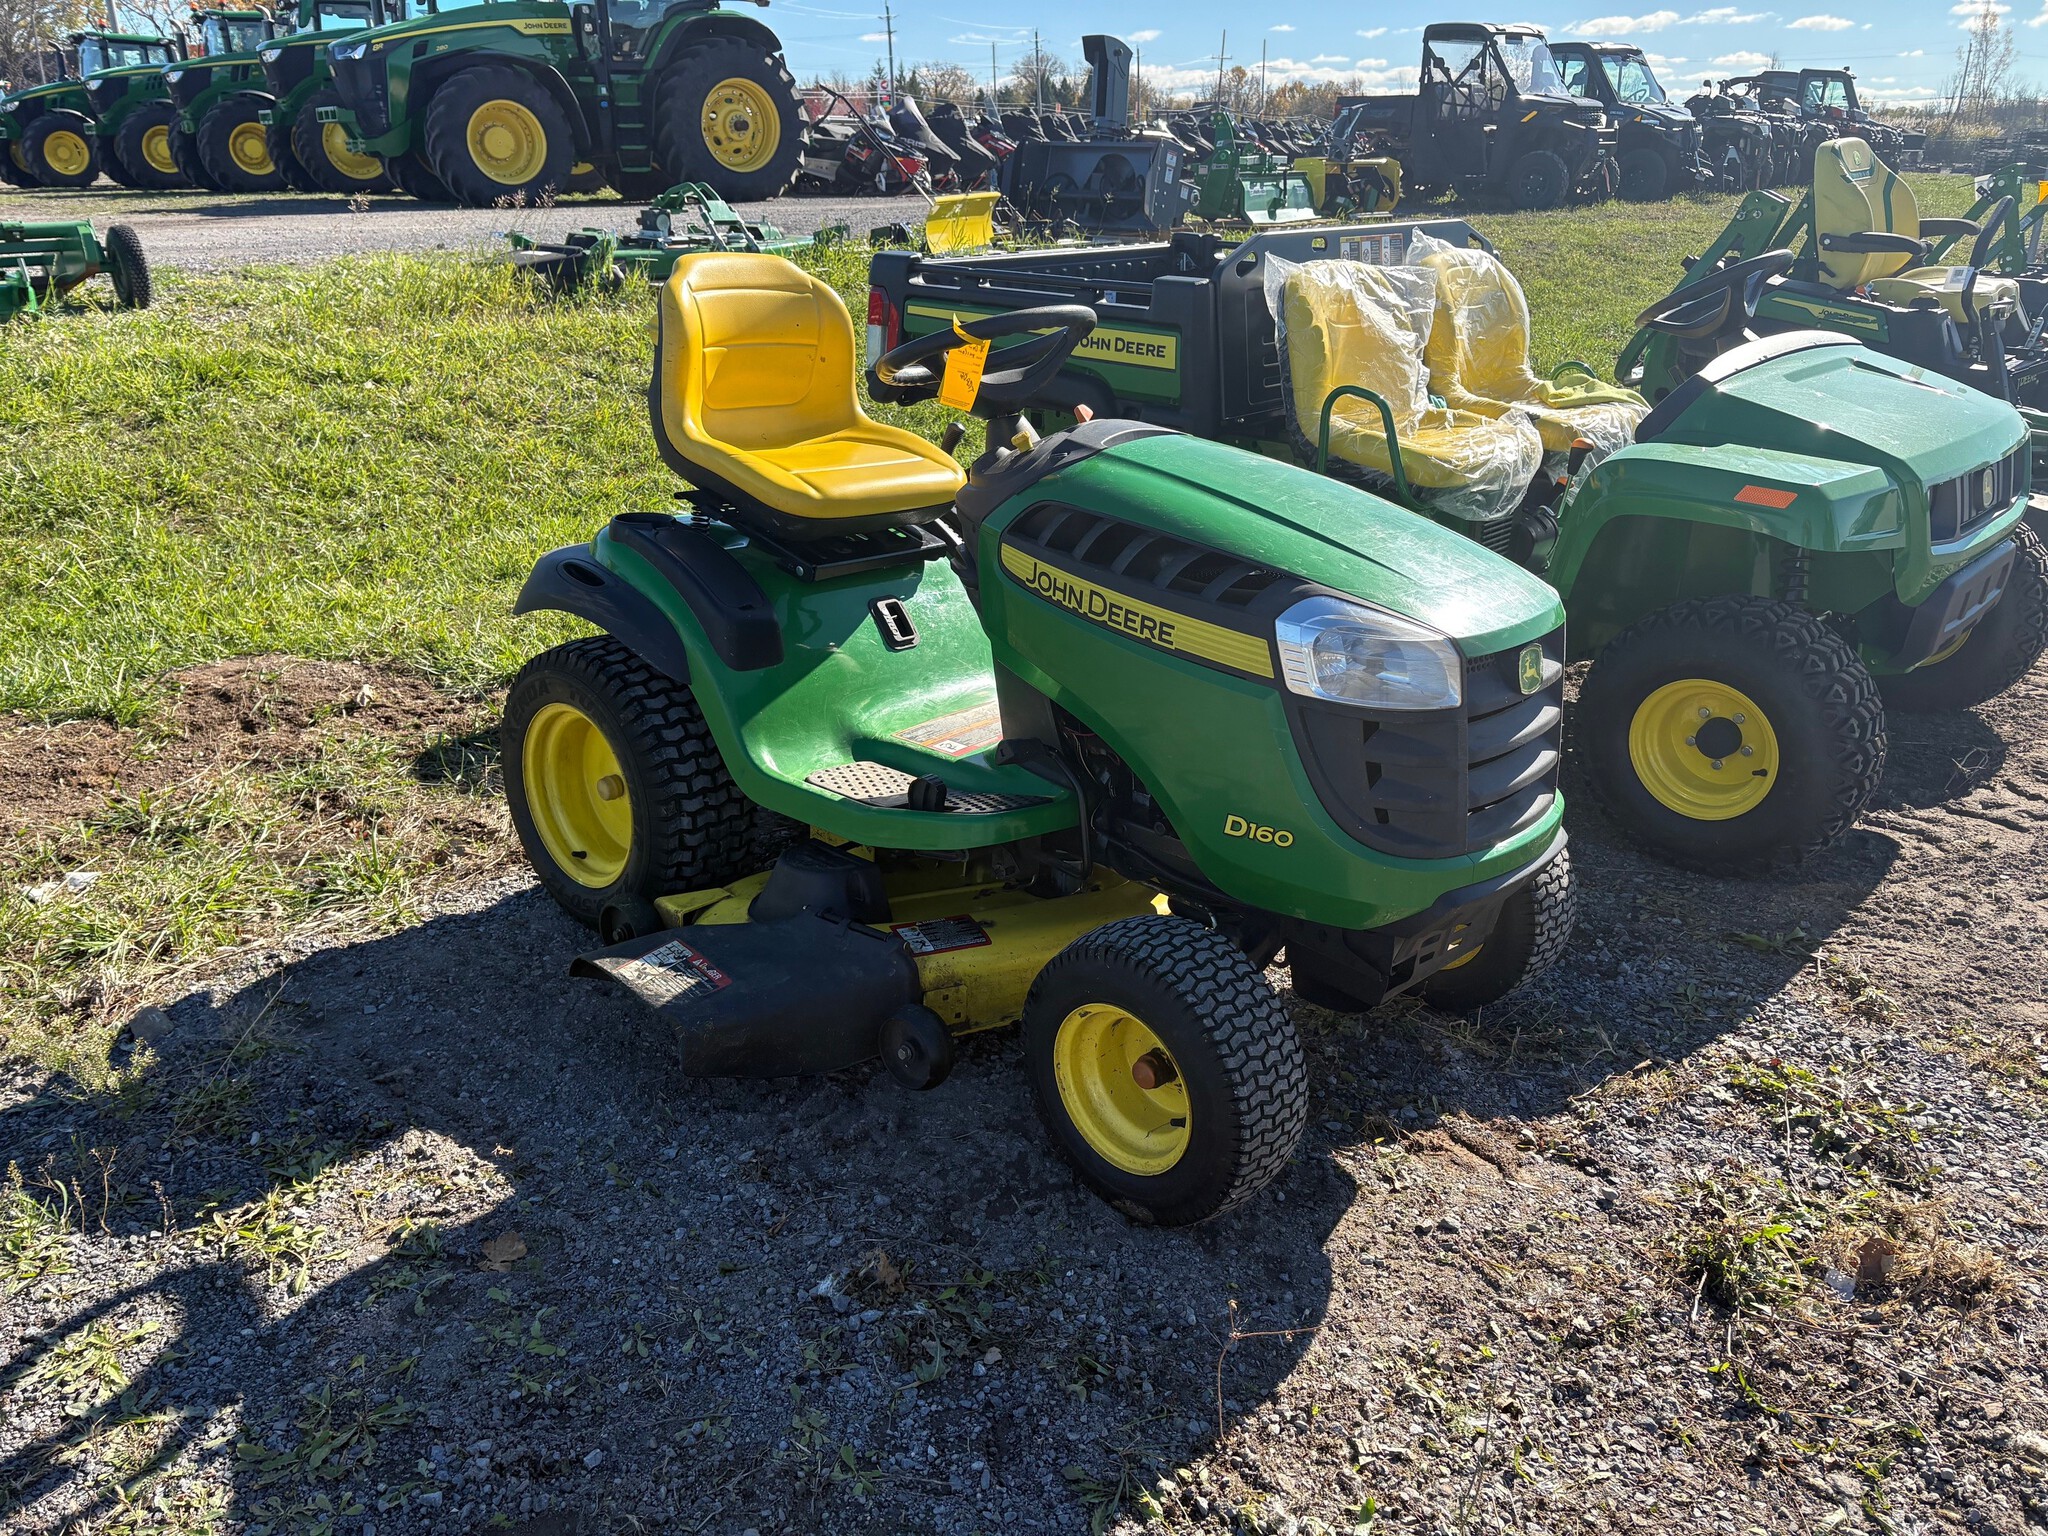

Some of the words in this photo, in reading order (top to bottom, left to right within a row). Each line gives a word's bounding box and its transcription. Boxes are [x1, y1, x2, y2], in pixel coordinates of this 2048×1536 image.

[1080, 336, 1111, 351] OHN
[1114, 336, 1166, 359] DEERE
[1025, 561, 1084, 611] JOHN
[1087, 589, 1176, 646] DEERE
[1222, 813, 1294, 848] D160
